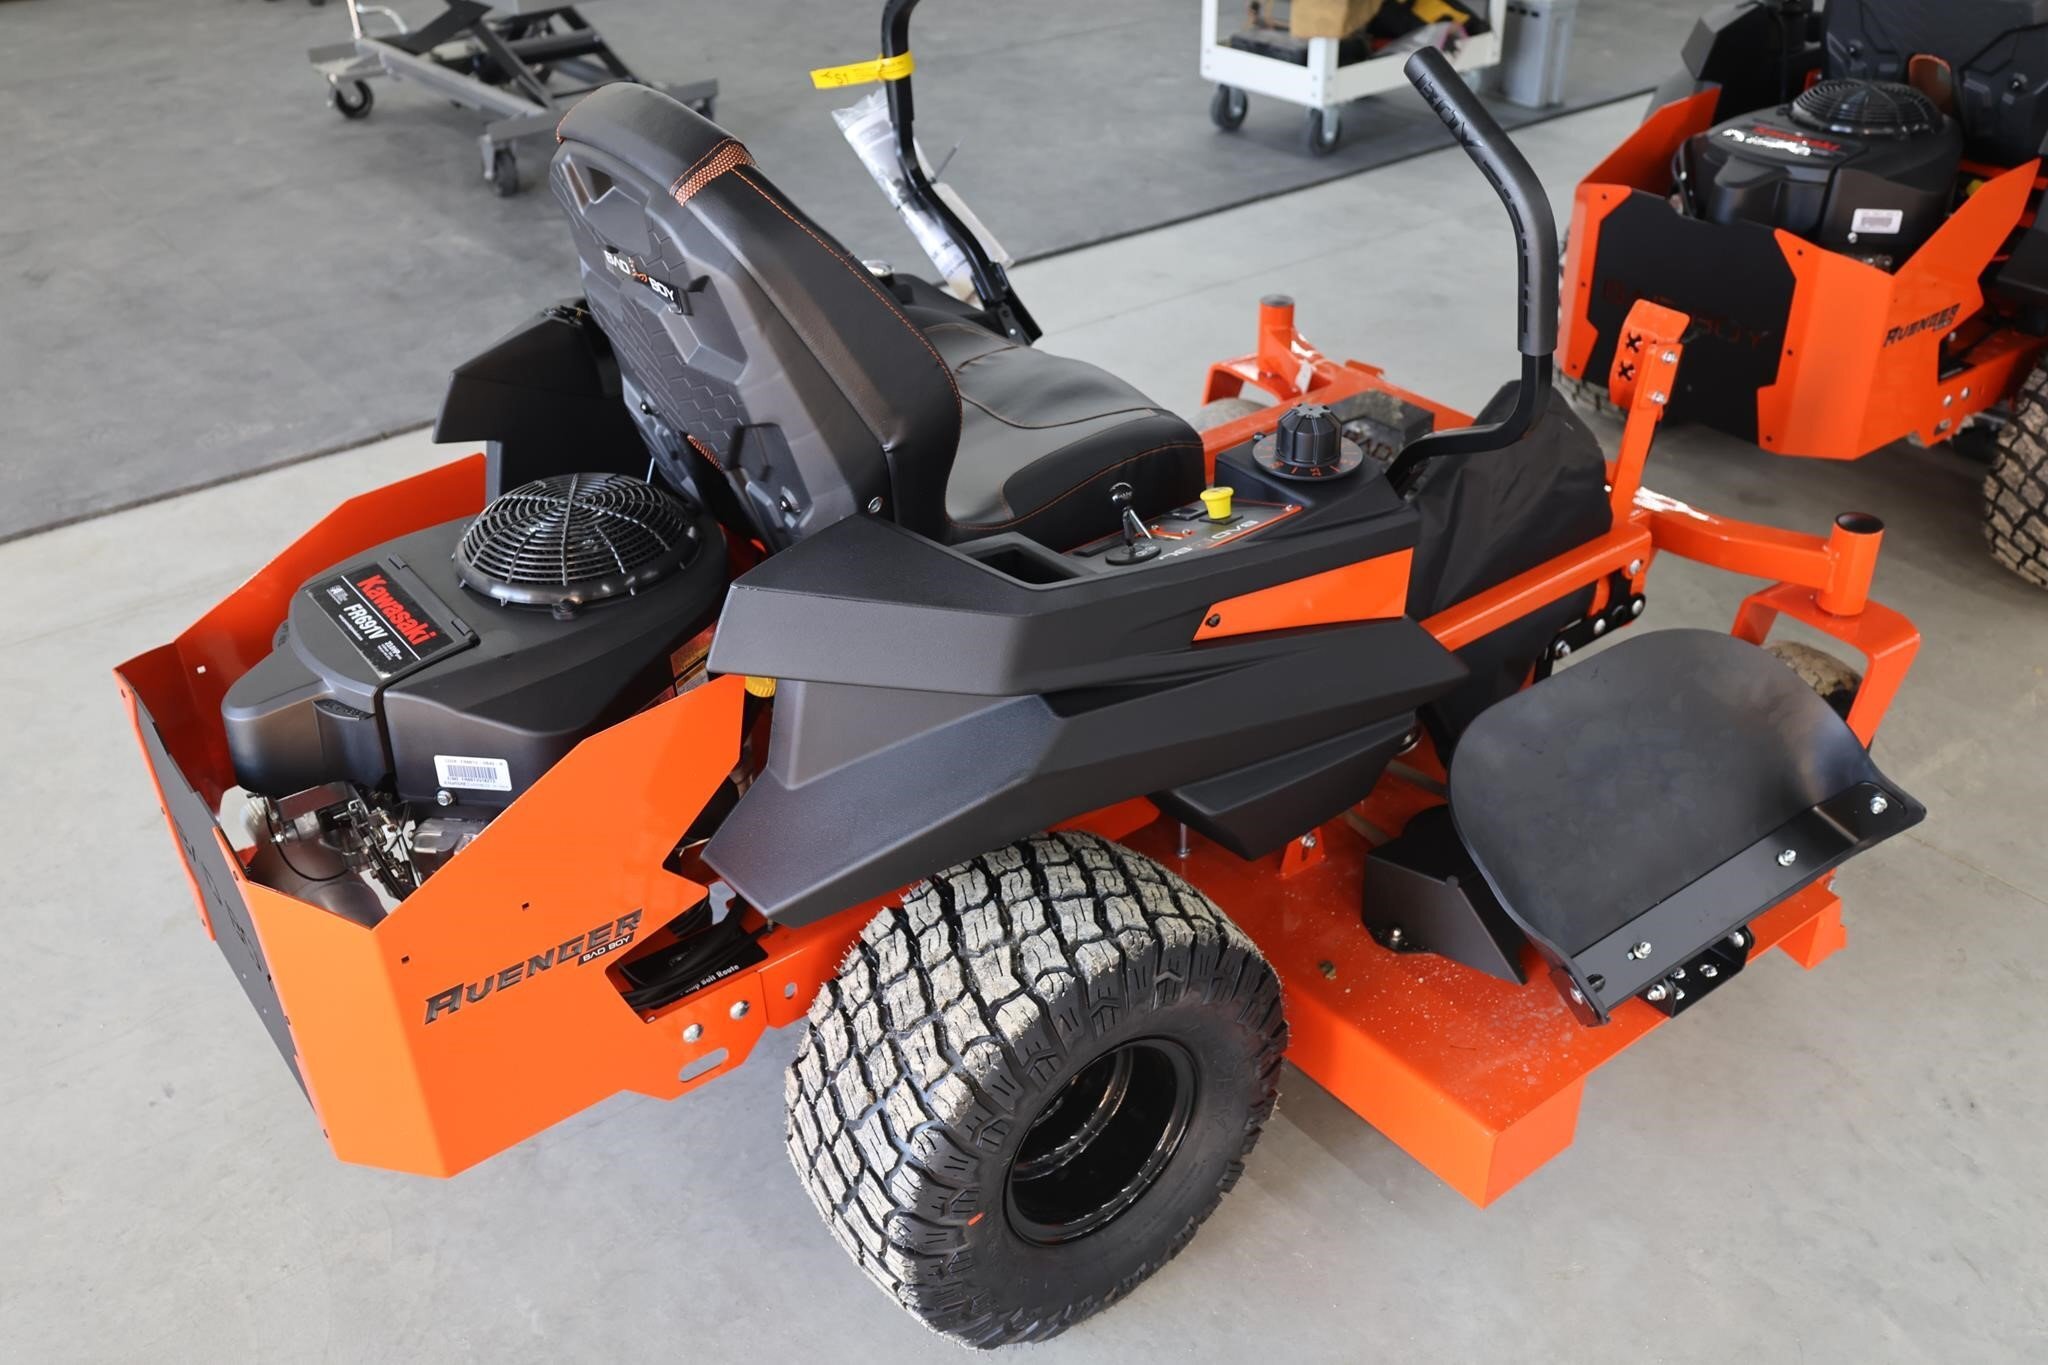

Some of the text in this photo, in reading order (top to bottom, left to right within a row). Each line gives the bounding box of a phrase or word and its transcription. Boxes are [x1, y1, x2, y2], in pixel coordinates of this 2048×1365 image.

[648, 276, 674, 301] BOY
[343, 602, 390, 640] FR691V
[356, 573, 438, 646] Kawasaki
[583, 935, 630, 962] BAD BOY
[715, 964, 740, 978] Route
